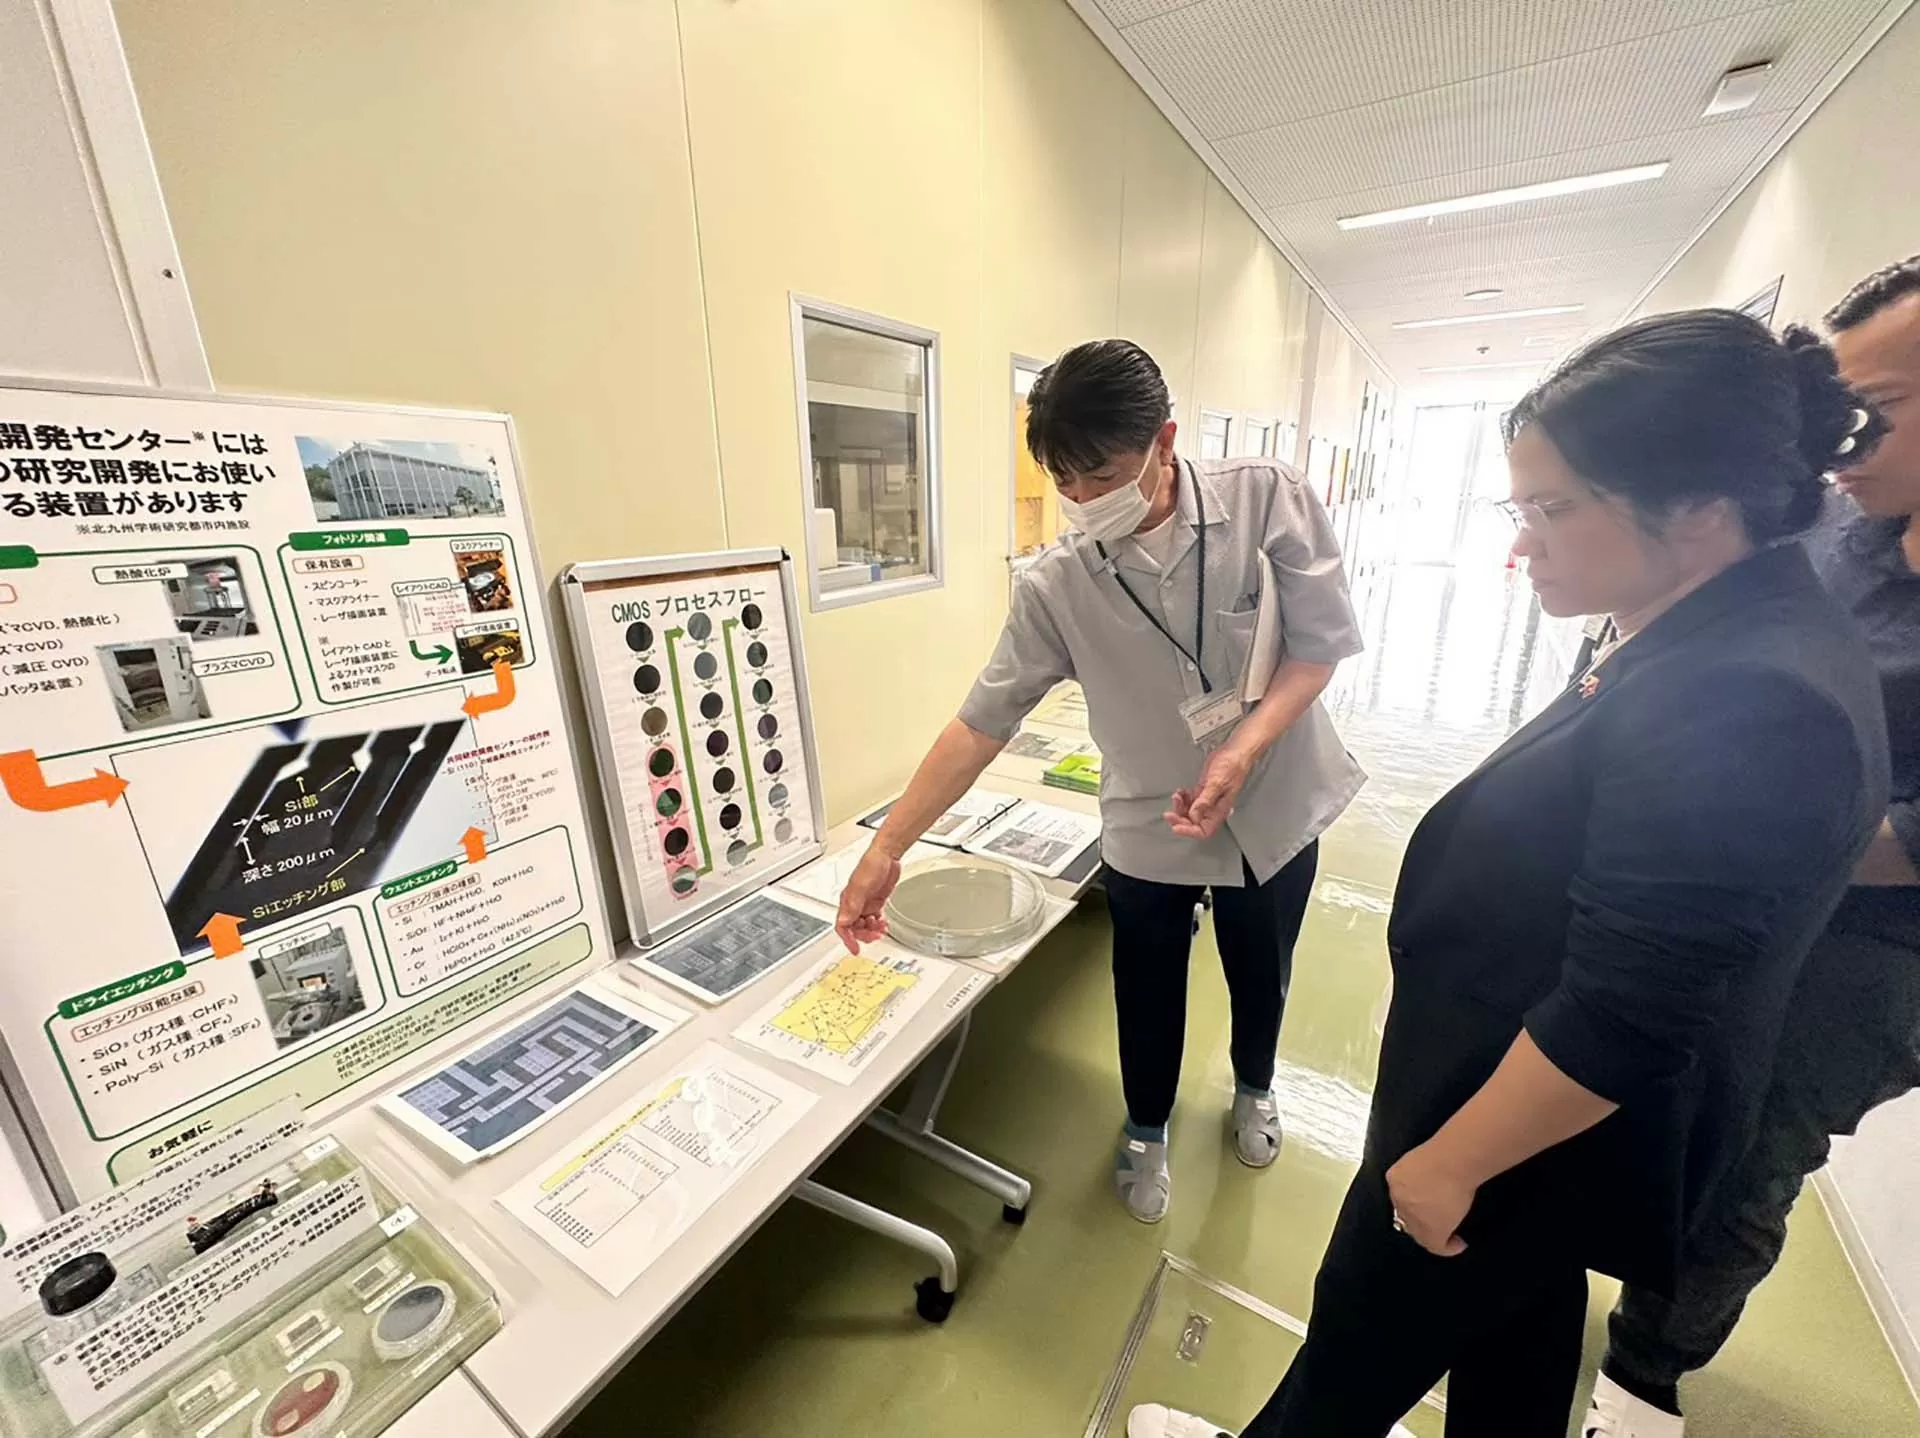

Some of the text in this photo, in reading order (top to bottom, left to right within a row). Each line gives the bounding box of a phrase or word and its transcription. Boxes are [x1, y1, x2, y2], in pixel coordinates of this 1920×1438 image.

[2, 490, 248, 517] る装置があります
[611, 588, 766, 623] CMOS プロセスフロー
[242, 864, 273, 884] 深さ
[99, 1057, 129, 1078] SiN
